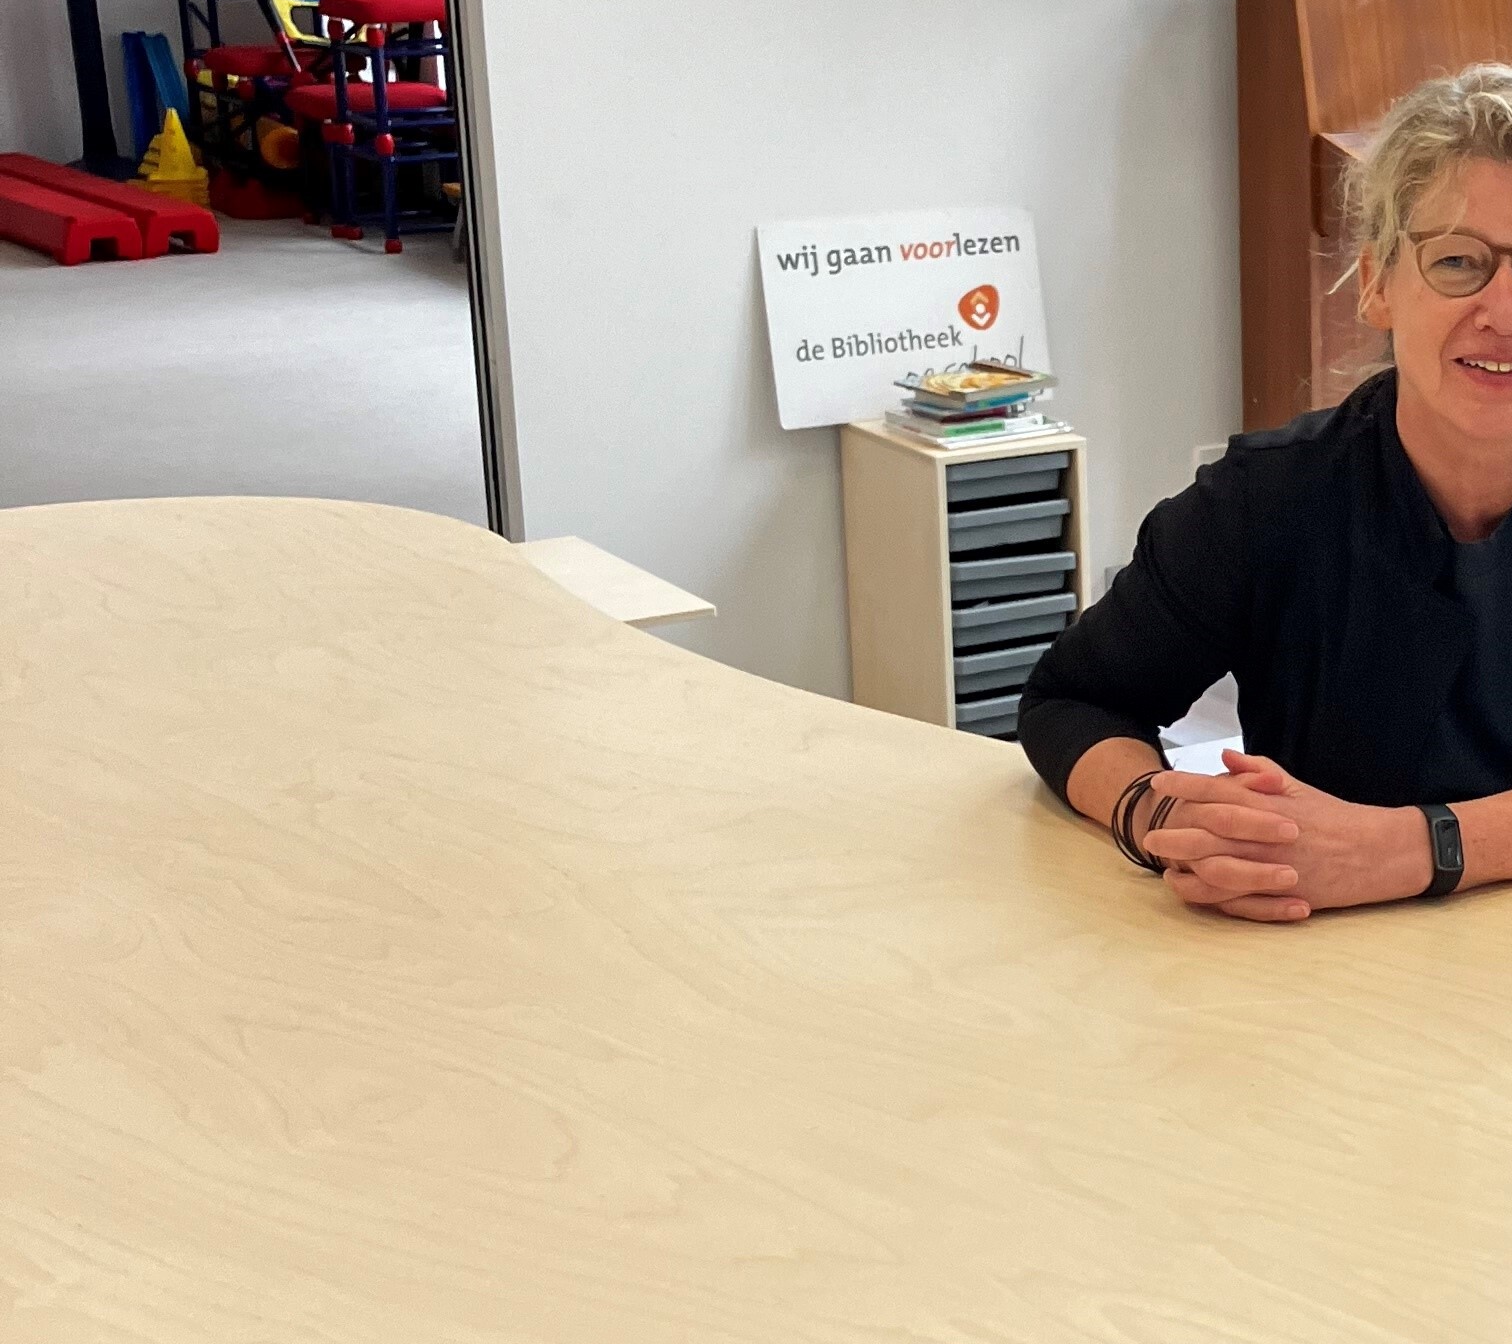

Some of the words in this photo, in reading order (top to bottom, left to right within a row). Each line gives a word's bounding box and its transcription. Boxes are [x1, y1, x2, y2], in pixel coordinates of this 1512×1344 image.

[777, 245, 818, 276] wij
[826, 243, 892, 275] gaan
[900, 232, 1020, 261] voorlezen
[796, 339, 824, 362] de
[832, 326, 963, 359] Bibliotheek
